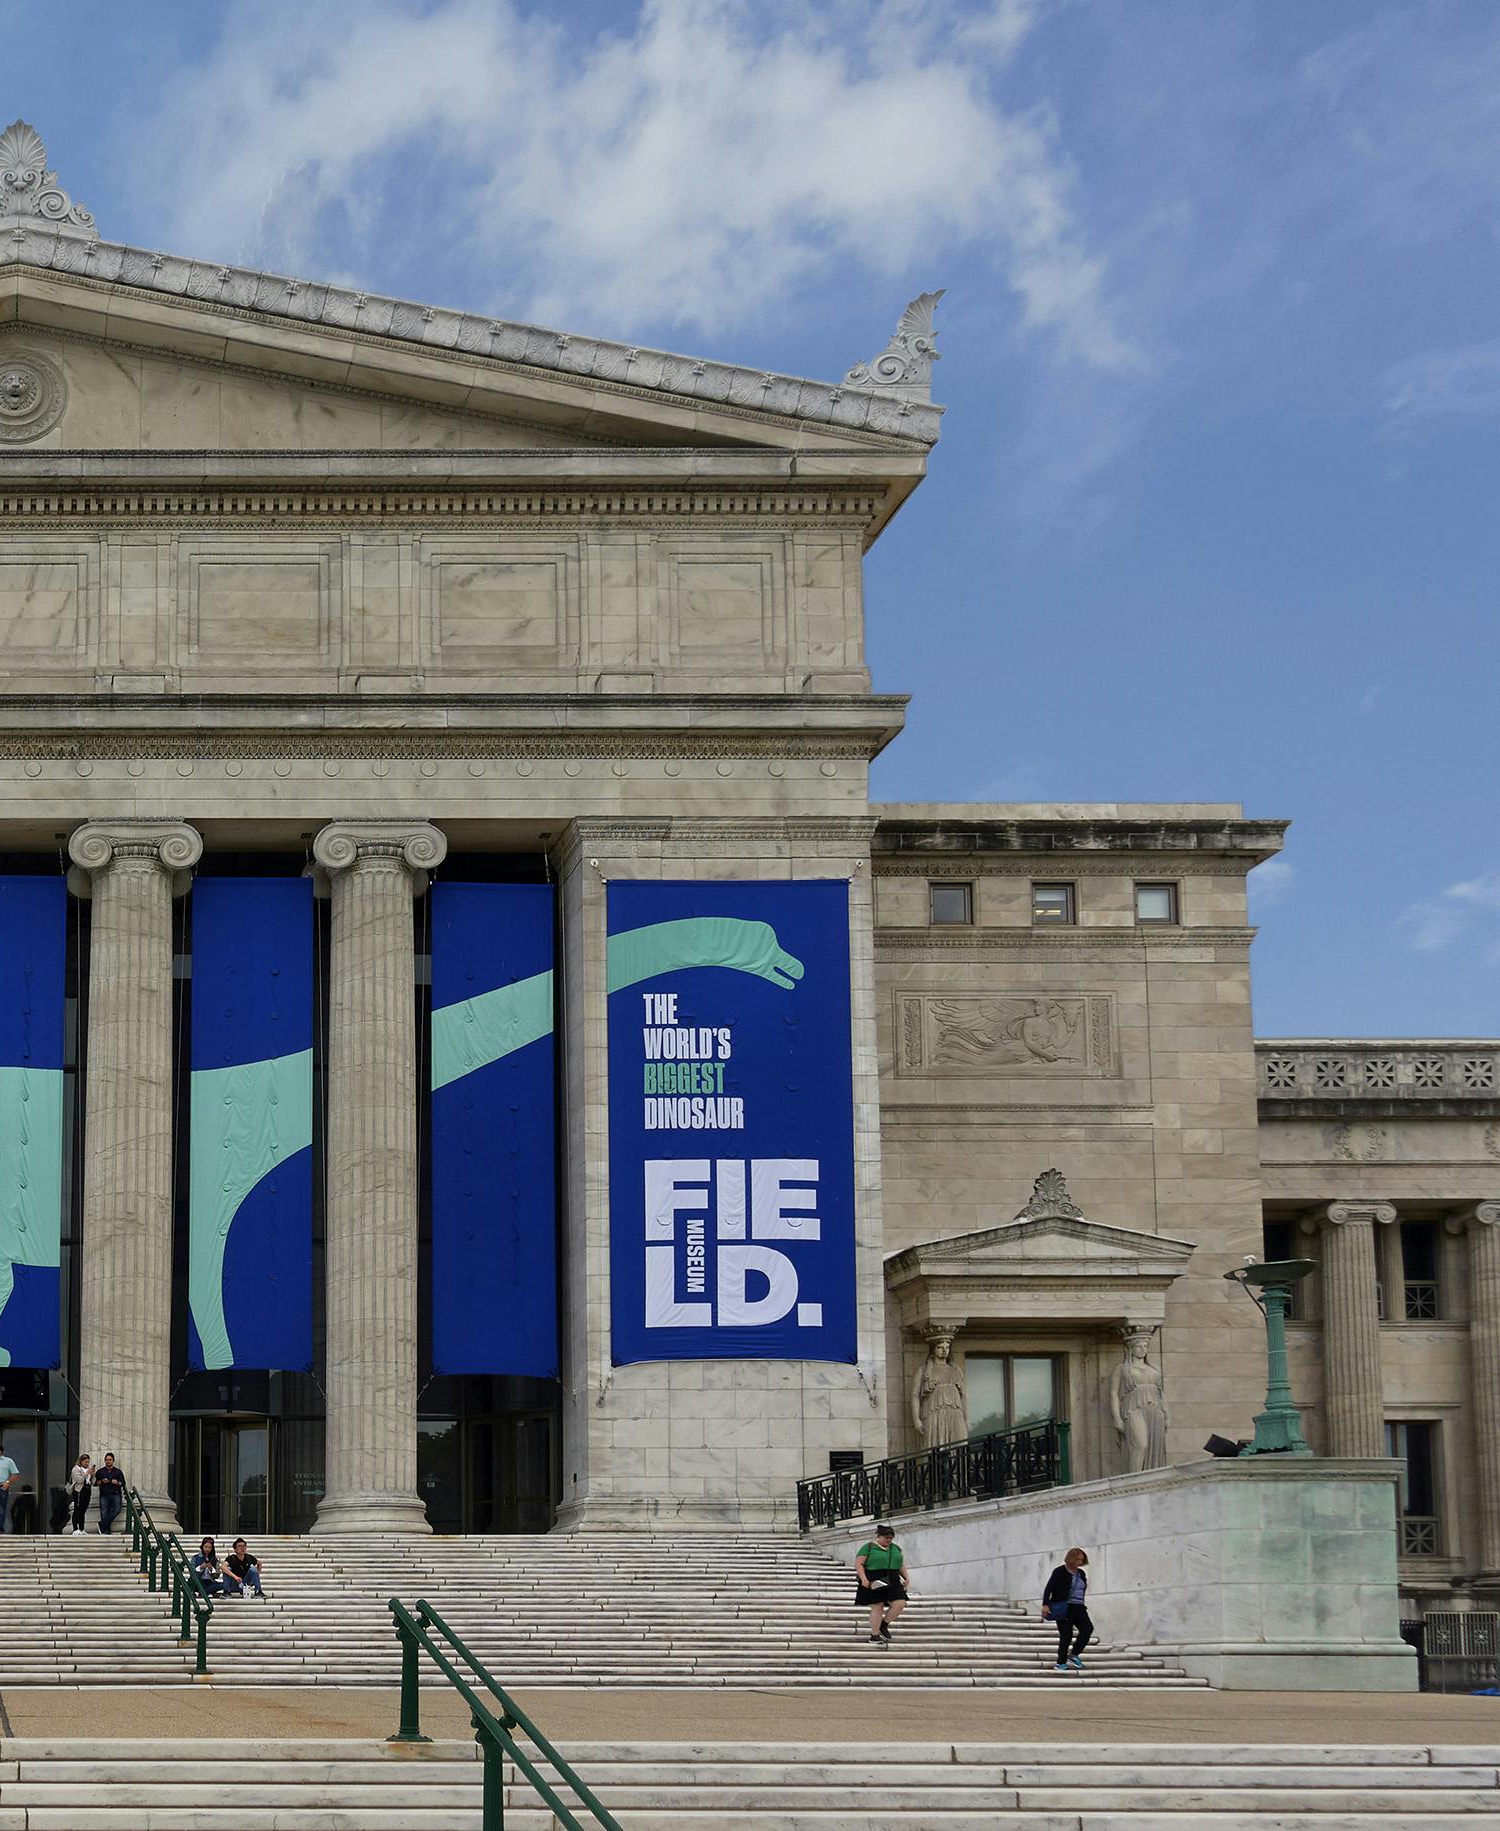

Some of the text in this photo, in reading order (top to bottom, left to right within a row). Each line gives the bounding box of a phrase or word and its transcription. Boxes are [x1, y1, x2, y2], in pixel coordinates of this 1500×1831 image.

[643, 993, 678, 1025] THE
[643, 1028, 731, 1060] WORLD'S
[644, 1063, 726, 1095] BIGGEST
[644, 1097, 744, 1130] DINOSAUR
[686, 1219, 705, 1293] MUSEUM
